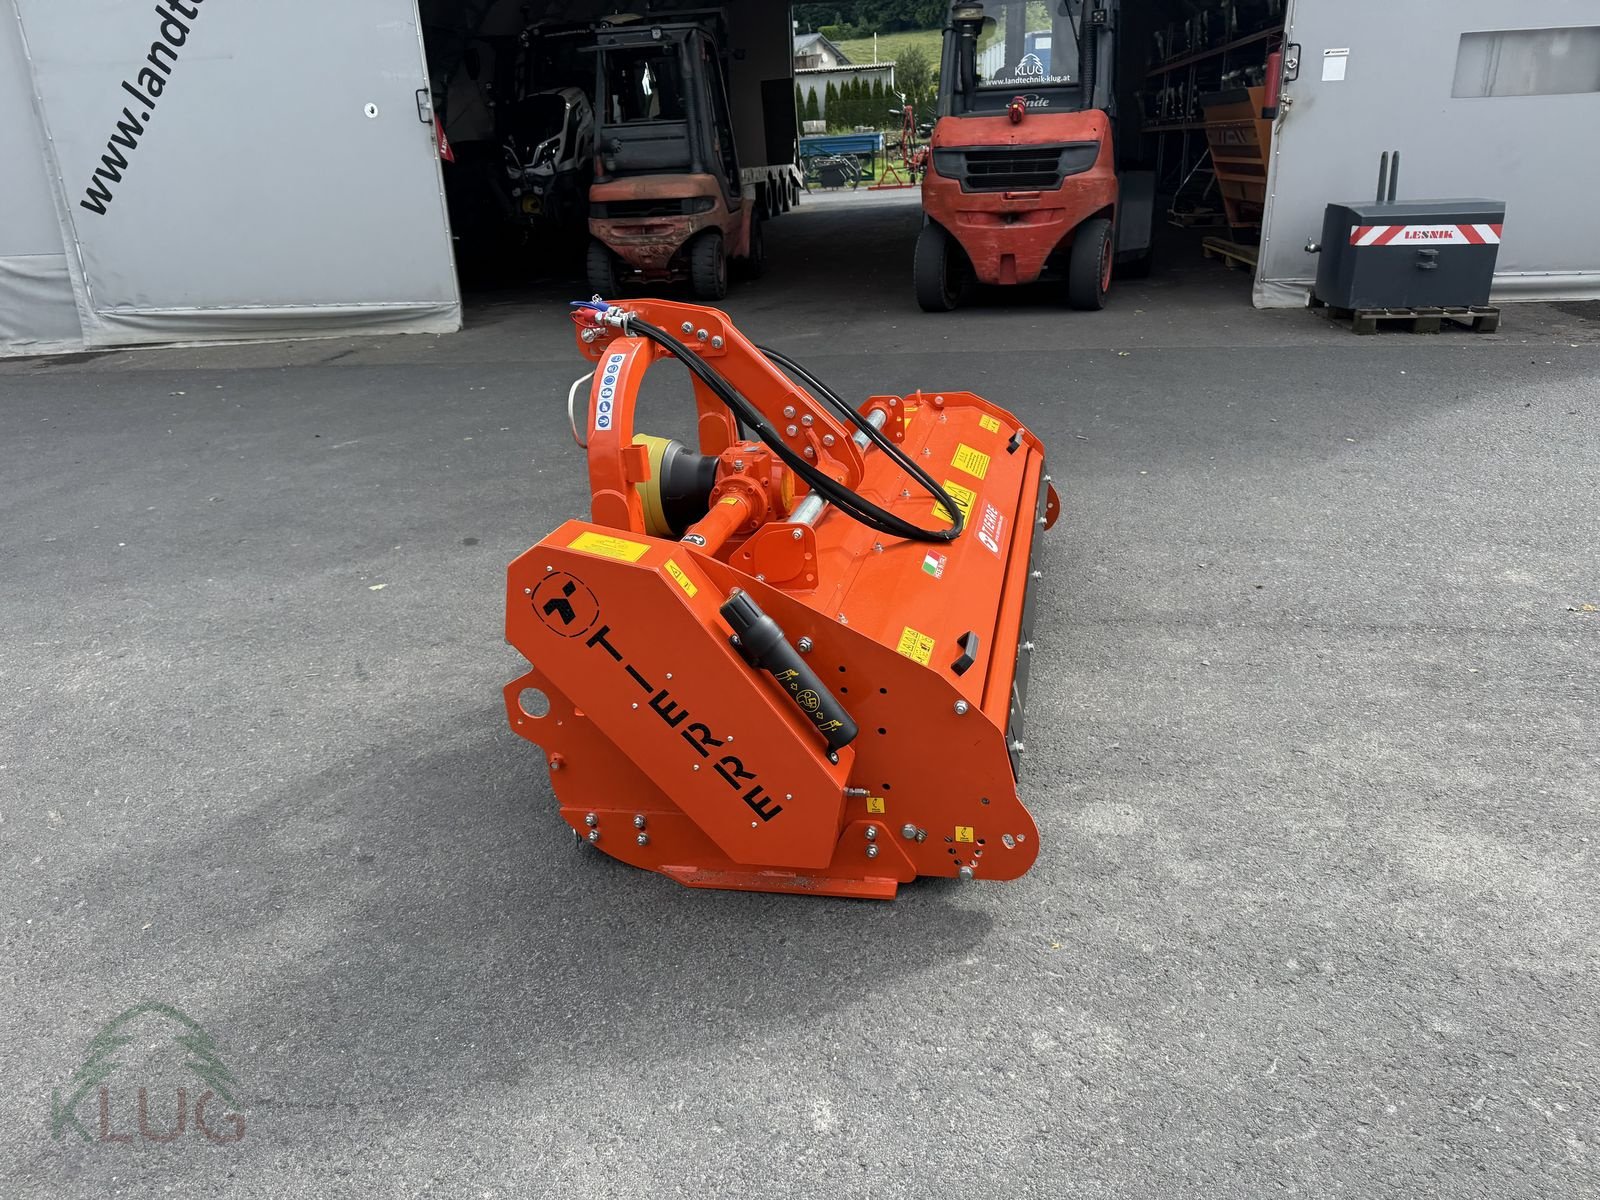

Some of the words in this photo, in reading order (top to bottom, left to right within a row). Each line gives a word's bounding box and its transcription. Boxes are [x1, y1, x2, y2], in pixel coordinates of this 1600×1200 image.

[986, 75, 1071, 86] www.landtechnik-klug.at
[1014, 65, 1044, 76] KLUG
[80, 0, 204, 215] www.landt
[1404, 230, 1453, 239] LESNIK
[981, 503, 998, 537] TIERRE
[586, 625, 783, 822] TIERRE
